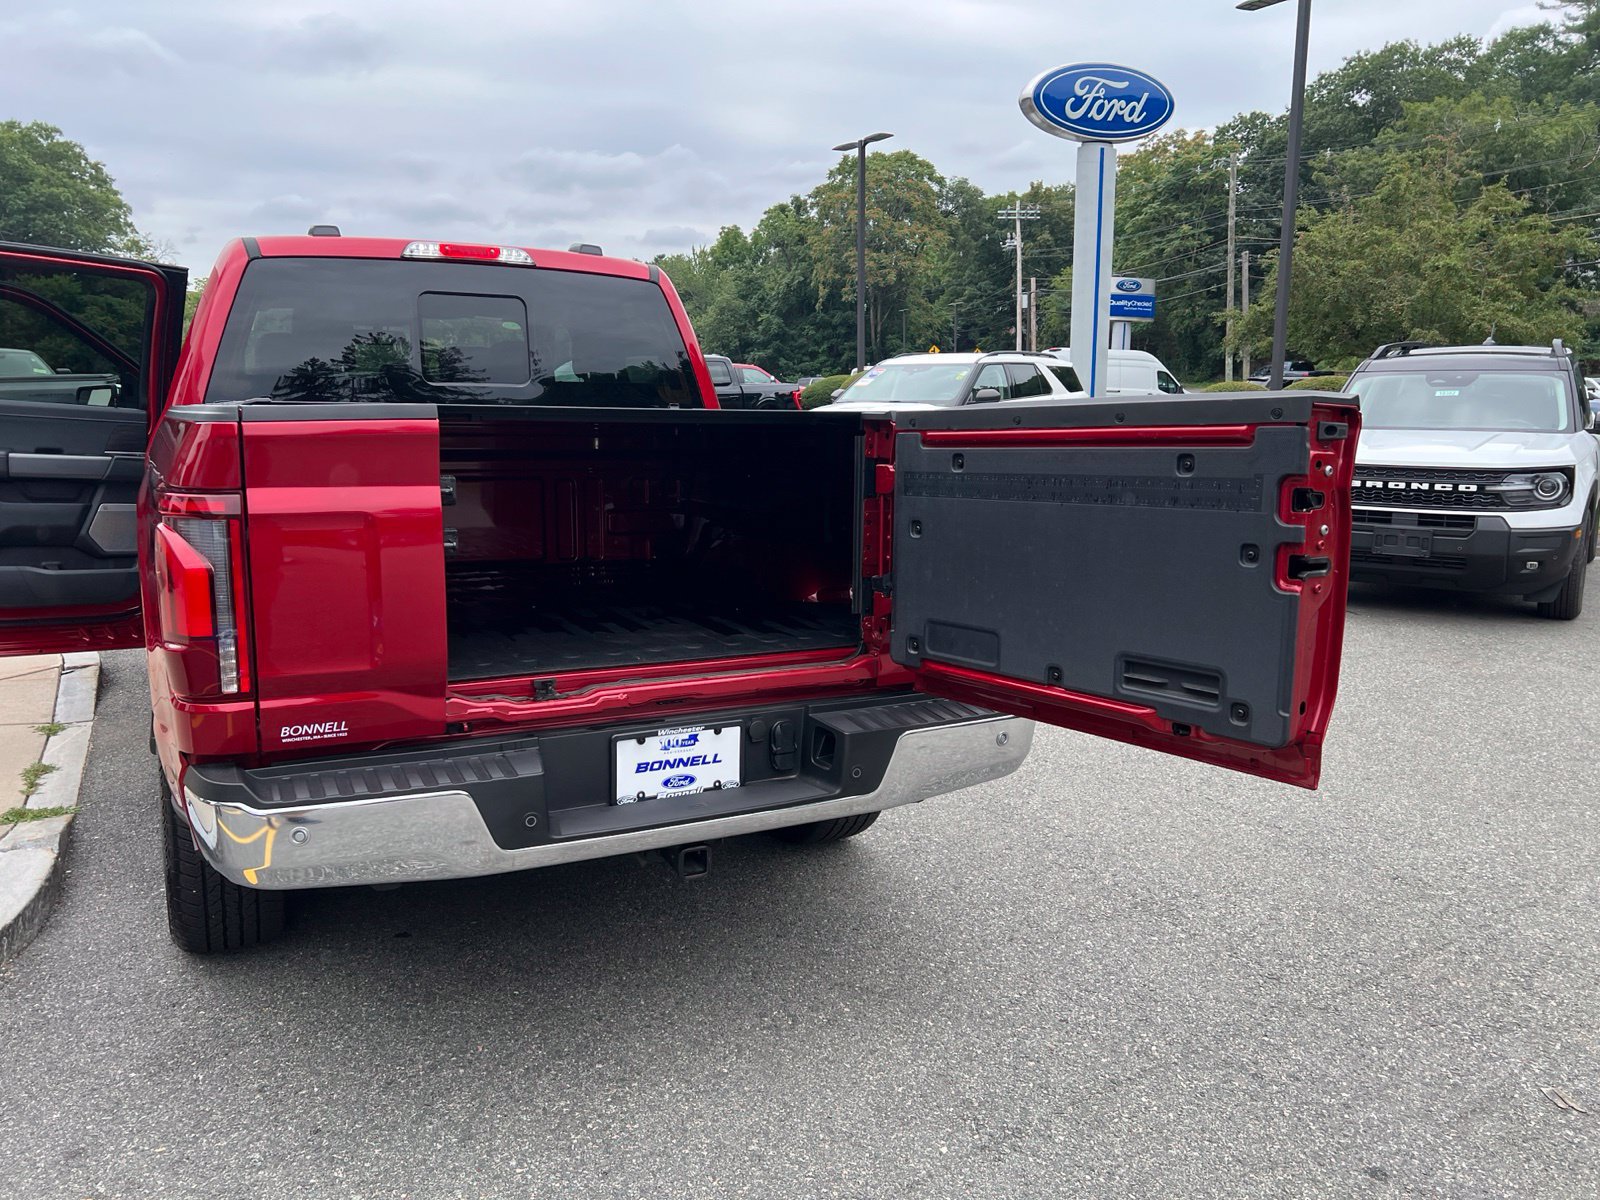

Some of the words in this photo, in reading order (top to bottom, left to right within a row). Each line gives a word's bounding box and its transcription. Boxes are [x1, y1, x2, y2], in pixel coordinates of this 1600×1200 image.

[1065, 76, 1149, 123] Ford
[1122, 281, 1138, 289] Ford
[281, 721, 348, 737] BONNELL
[658, 726, 705, 736] Winchester
[659, 736, 682, 750] 100
[681, 739, 696, 747] YEAR
[635, 753, 722, 774] BONNELL
[666, 776, 691, 788] Ford
[618, 796, 637, 805] Ford
